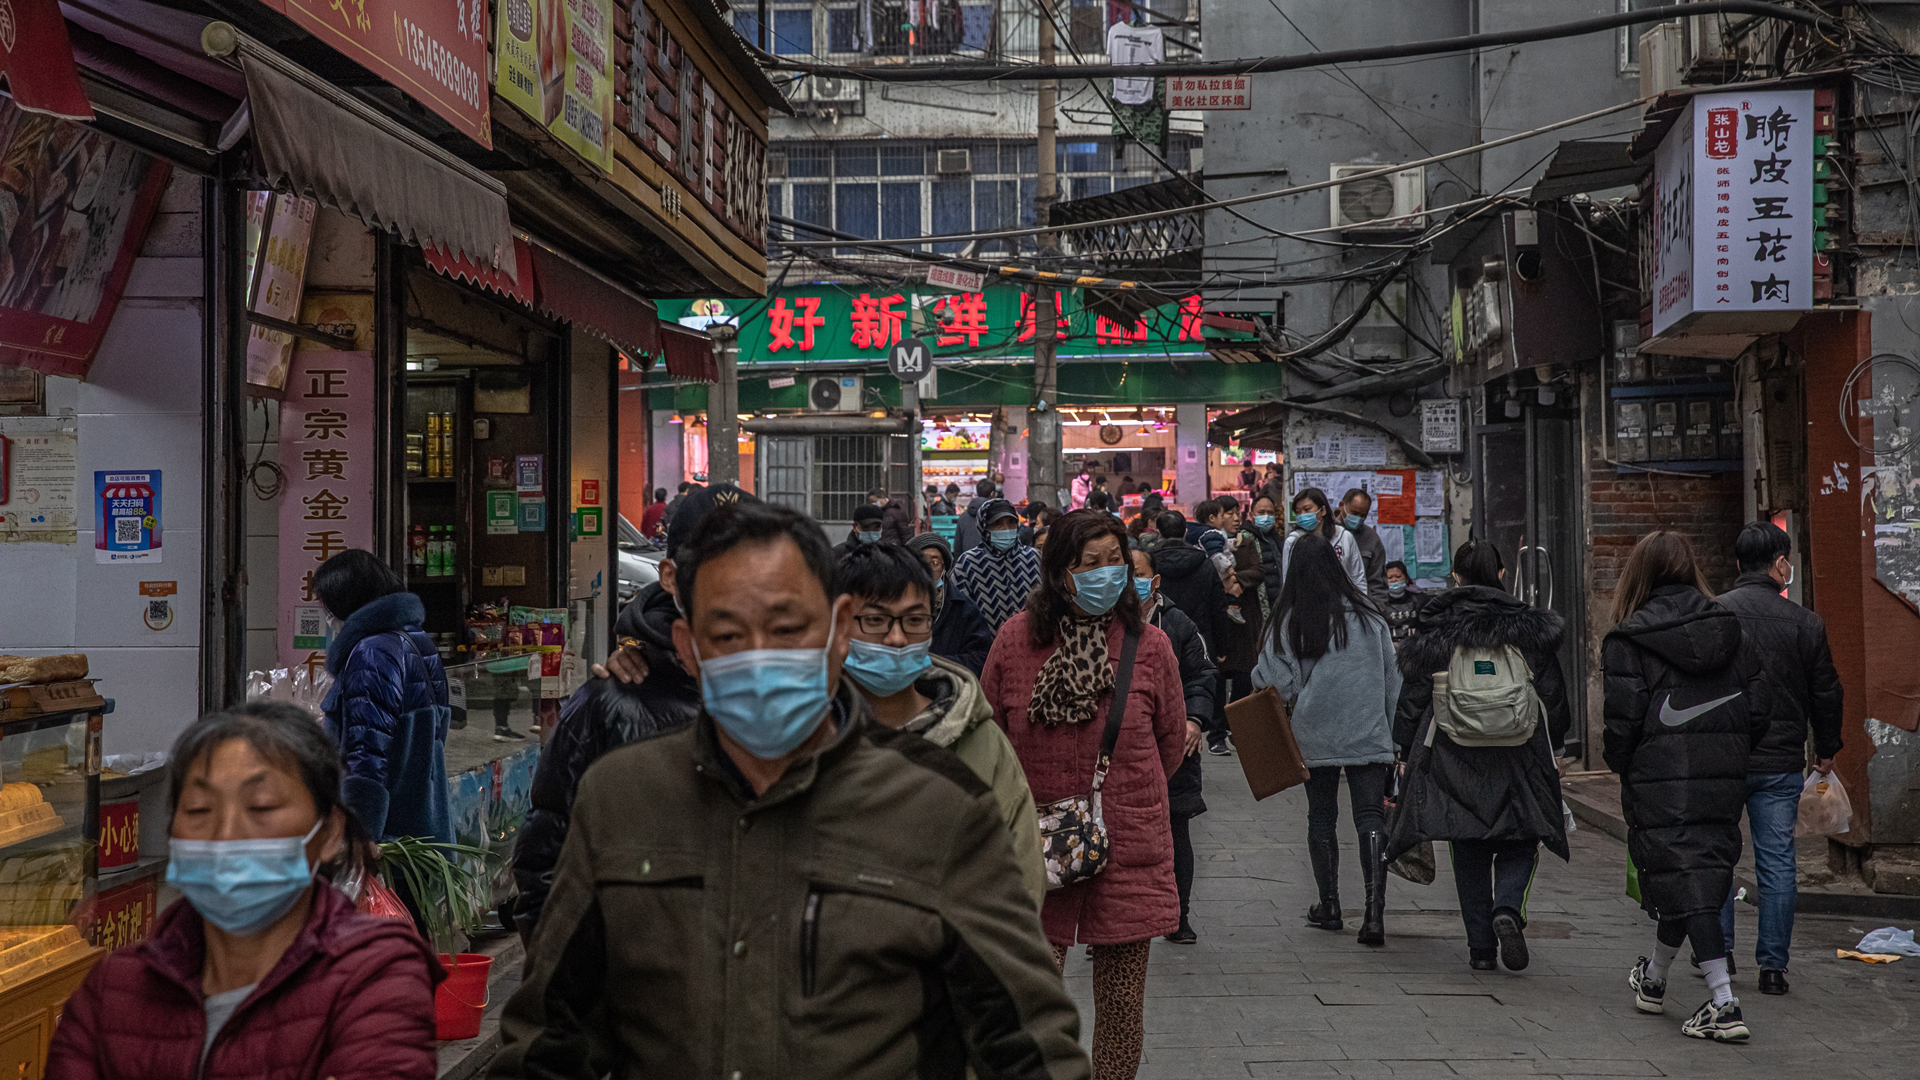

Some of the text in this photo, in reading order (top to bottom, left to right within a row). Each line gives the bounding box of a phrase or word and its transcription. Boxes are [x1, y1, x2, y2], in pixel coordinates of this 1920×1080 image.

[404, 17, 480, 110] 13545889038
[1172, 79, 1246, 91] 请勿私拉线缆
[1172, 95, 1245, 107] 美化社区环境
[1744, 105, 1799, 304] 脆皮五花肉
[111, 499, 145, 507] 天天扫码
